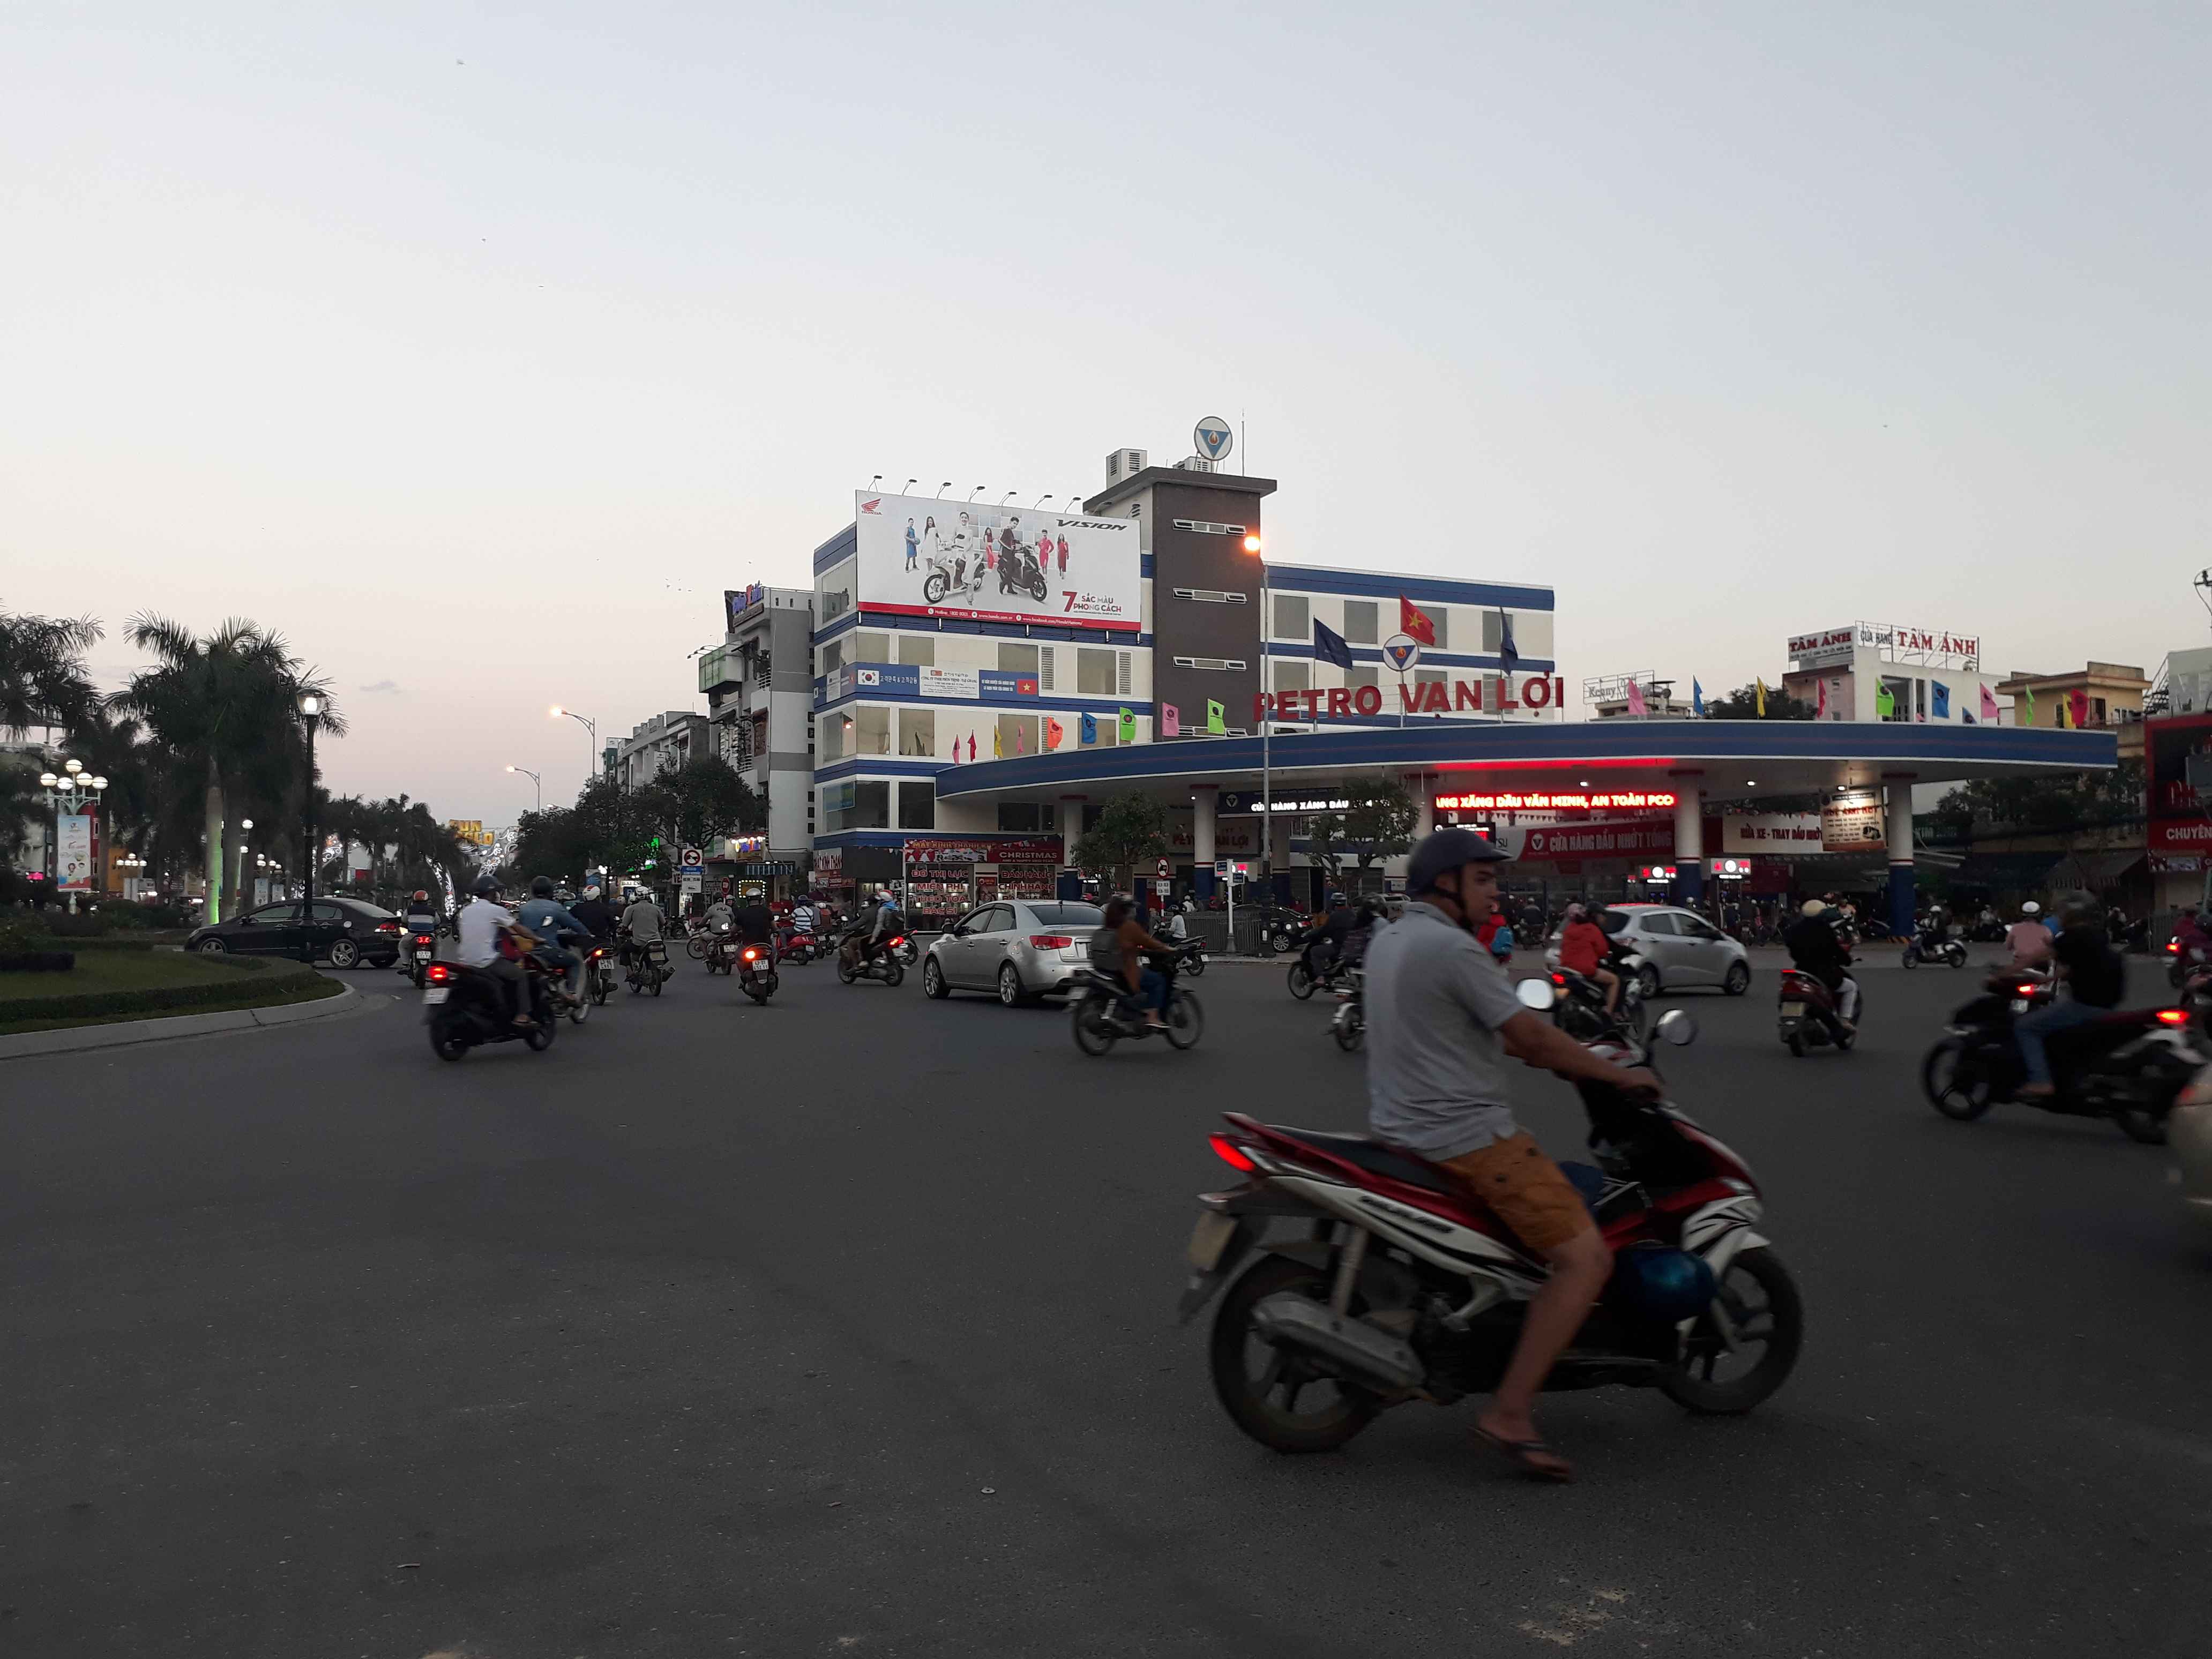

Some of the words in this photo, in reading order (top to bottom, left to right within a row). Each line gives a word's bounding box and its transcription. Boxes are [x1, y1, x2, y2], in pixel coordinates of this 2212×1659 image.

[1056, 519, 1127, 531] VISION
[1062, 591, 1078, 612] 7
[1073, 603, 1100, 611] PHONG
[1789, 636, 1818, 652] TÂM
[1897, 627, 1933, 651] TÂM
[1253, 685, 1382, 722] PETRO
[1398, 679, 1482, 720] VẠN
[1496, 670, 1564, 718] LỢI
[1591, 795, 1609, 806] AN
[1611, 793, 1645, 806] TOÀN
